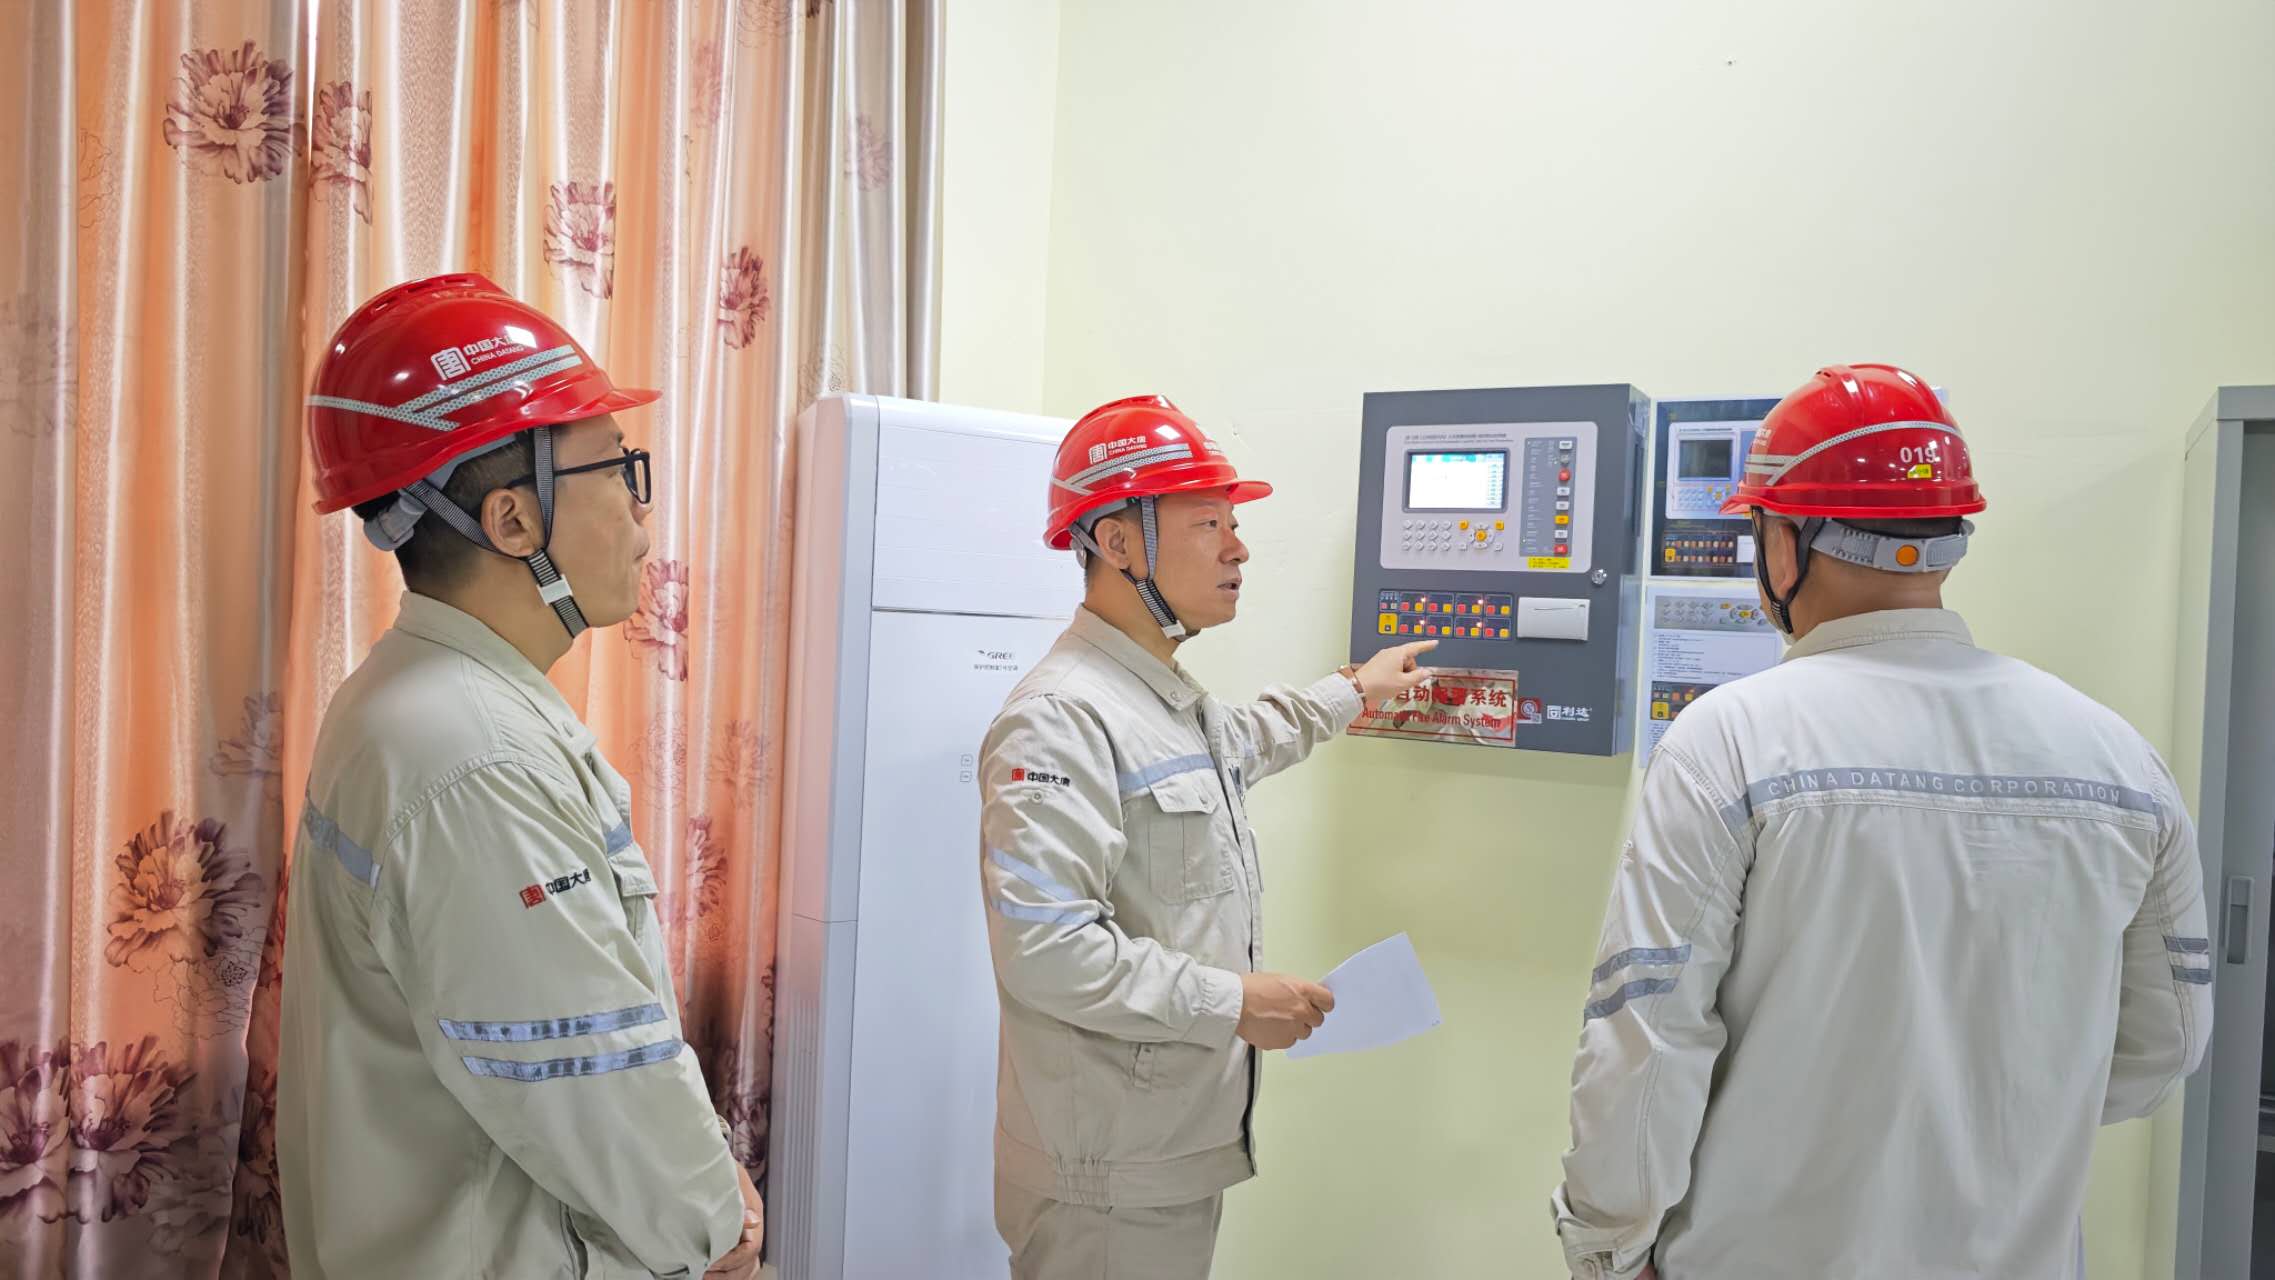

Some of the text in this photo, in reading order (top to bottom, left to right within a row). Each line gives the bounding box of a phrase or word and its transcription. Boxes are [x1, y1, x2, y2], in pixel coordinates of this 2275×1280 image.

[463, 334, 514, 355] 中国大
[471, 351, 497, 364] CHINA
[1900, 446, 1937, 464] 019
[1463, 713, 1502, 729] System
[1767, 771, 2120, 804] CHINA DATANG CORPORATION
